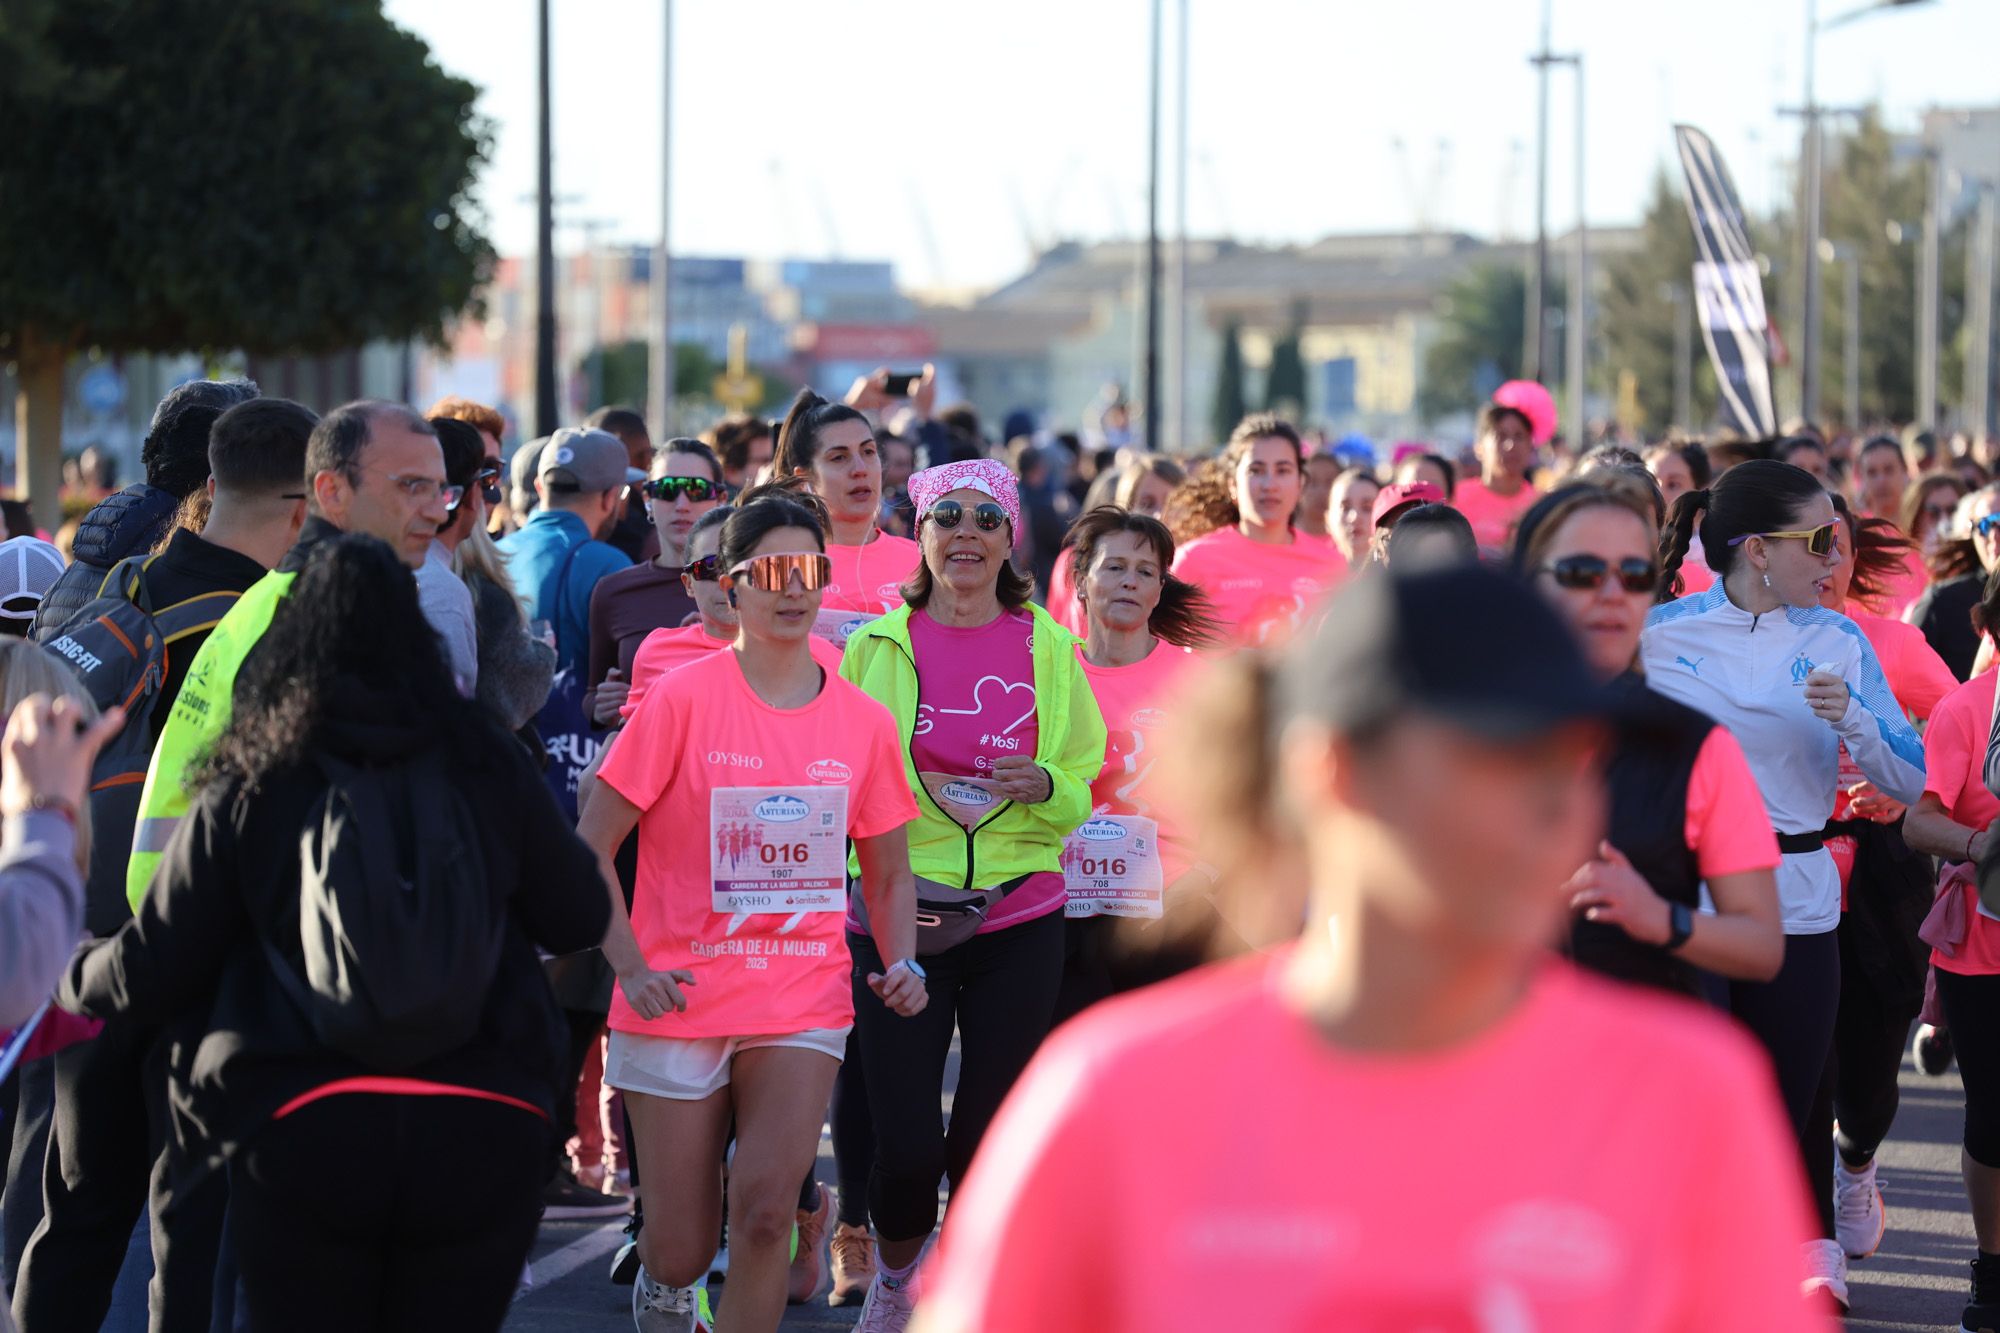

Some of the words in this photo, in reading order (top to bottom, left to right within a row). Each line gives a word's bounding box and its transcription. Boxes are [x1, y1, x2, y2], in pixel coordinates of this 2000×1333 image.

[708, 751, 763, 770] OYSHO
[943, 787, 990, 803] ASTURIANA
[758, 805, 806, 817] ASTURIANA
[1079, 826, 1124, 838] ASTURIANA
[760, 843, 809, 863] 016
[1081, 858, 1126, 876] 016
[771, 869, 793, 879] 1907
[730, 882, 759, 890] CARRERA
[769, 881, 779, 889] LA
[779, 881, 800, 889] MUJER
[803, 880, 830, 888] VALENCIA
[1093, 879, 1109, 888] 708
[728, 895, 771, 906] OYSHO
[795, 894, 831, 905] Santander
[1122, 890, 1148, 898] VALENCIA
[1064, 902, 1091, 912] YSHO
[691, 940, 744, 958] CARRERA
[746, 939, 762, 955] DE
[764, 940, 779, 955] LA
[783, 941, 827, 957] MUJER
[745, 957, 768, 970] 2025
